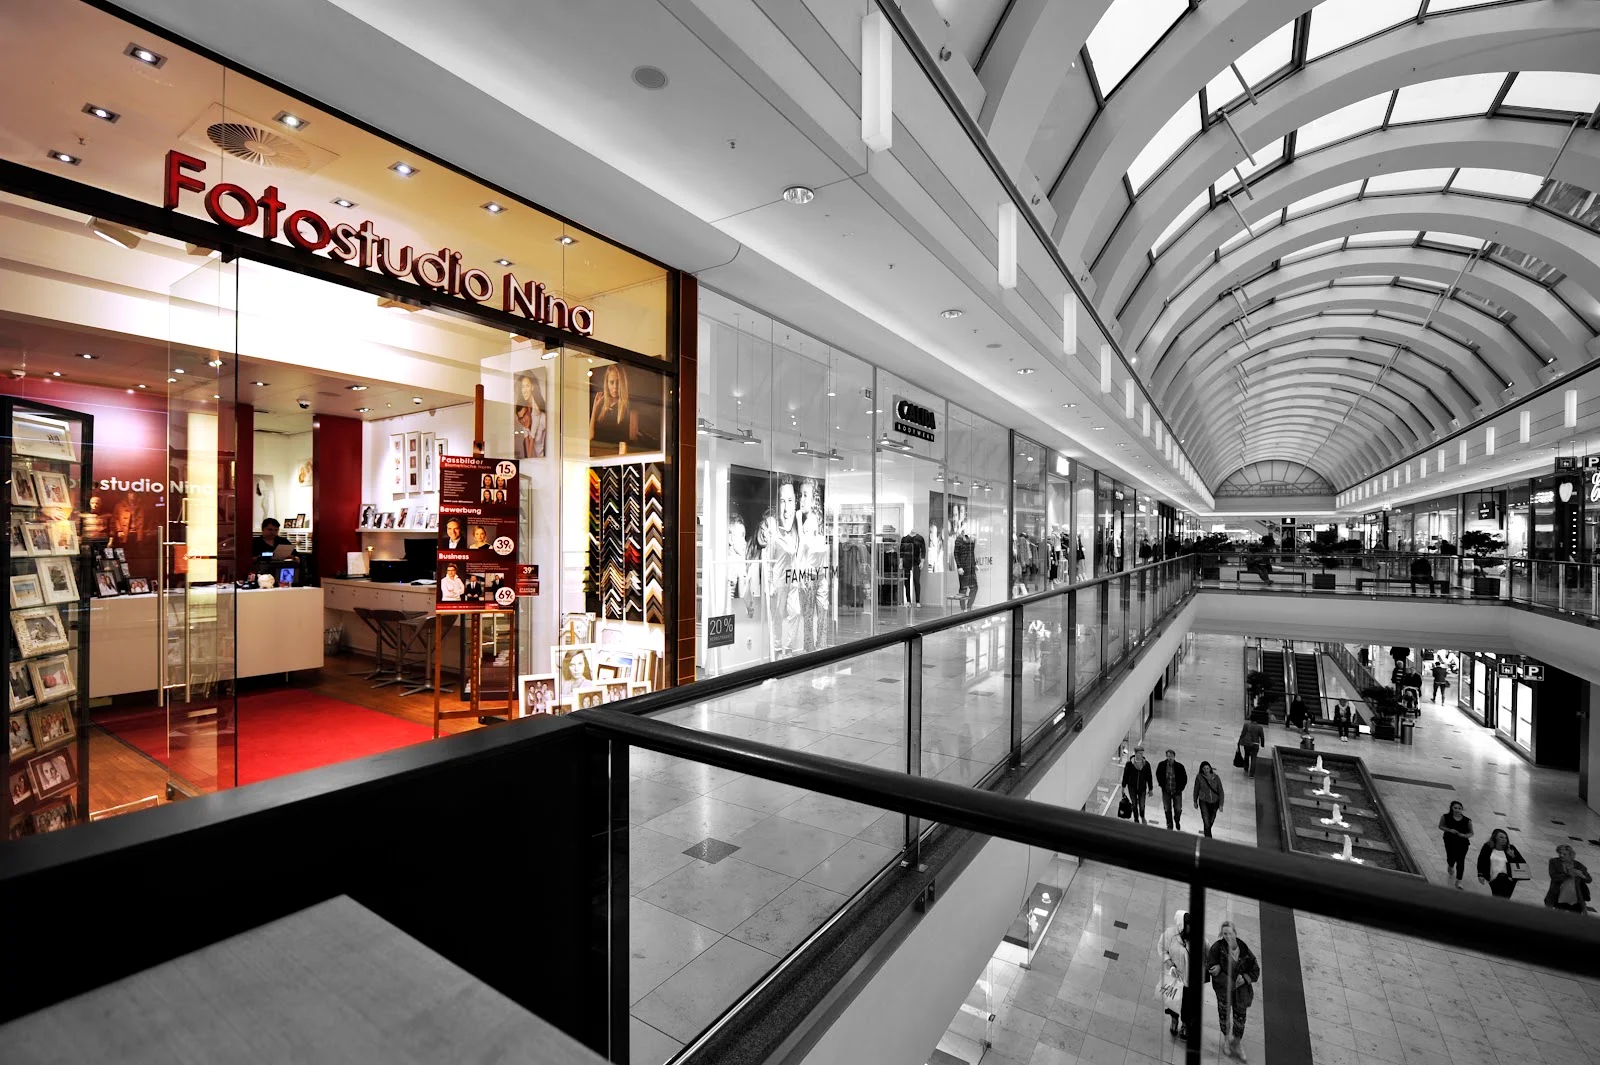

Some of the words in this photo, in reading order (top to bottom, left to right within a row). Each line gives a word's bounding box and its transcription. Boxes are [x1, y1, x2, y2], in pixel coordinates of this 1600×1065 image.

[164, 149, 494, 302] Fotostudio
[503, 272, 596, 336] Nina
[441, 456, 484, 465] Passbilder
[440, 506, 482, 515] Bewerbung
[785, 567, 821, 584] FAMILY
[823, 566, 838, 579] TM
[1528, 666, 1539, 676] P
